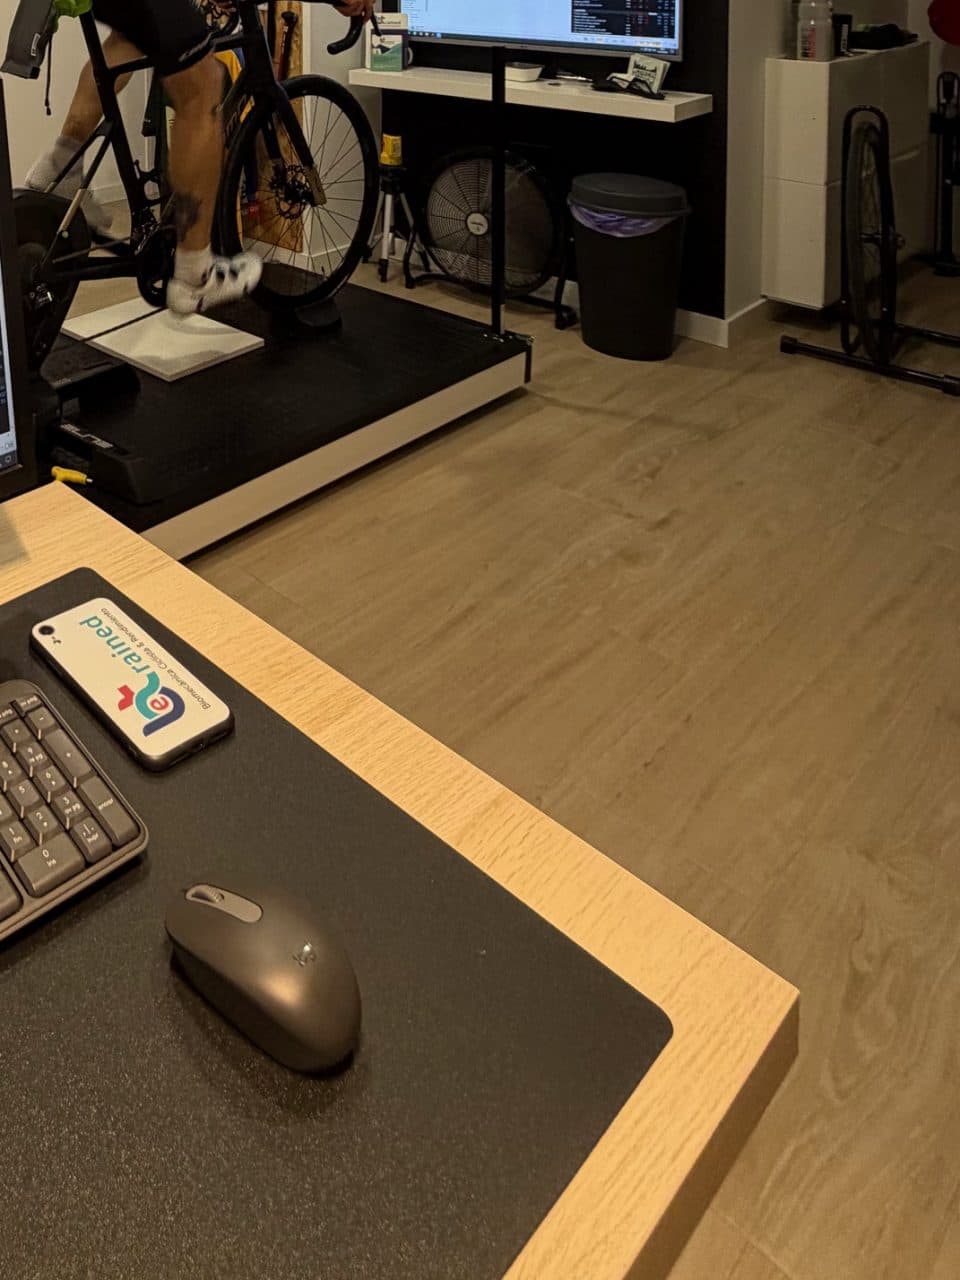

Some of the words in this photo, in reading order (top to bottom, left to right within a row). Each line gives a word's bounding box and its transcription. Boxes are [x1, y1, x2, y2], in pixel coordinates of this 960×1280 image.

[143, 646, 168, 671] Ciclista
[167, 667, 212, 711] Biomecánica
[42, 849, 50, 858] 0
